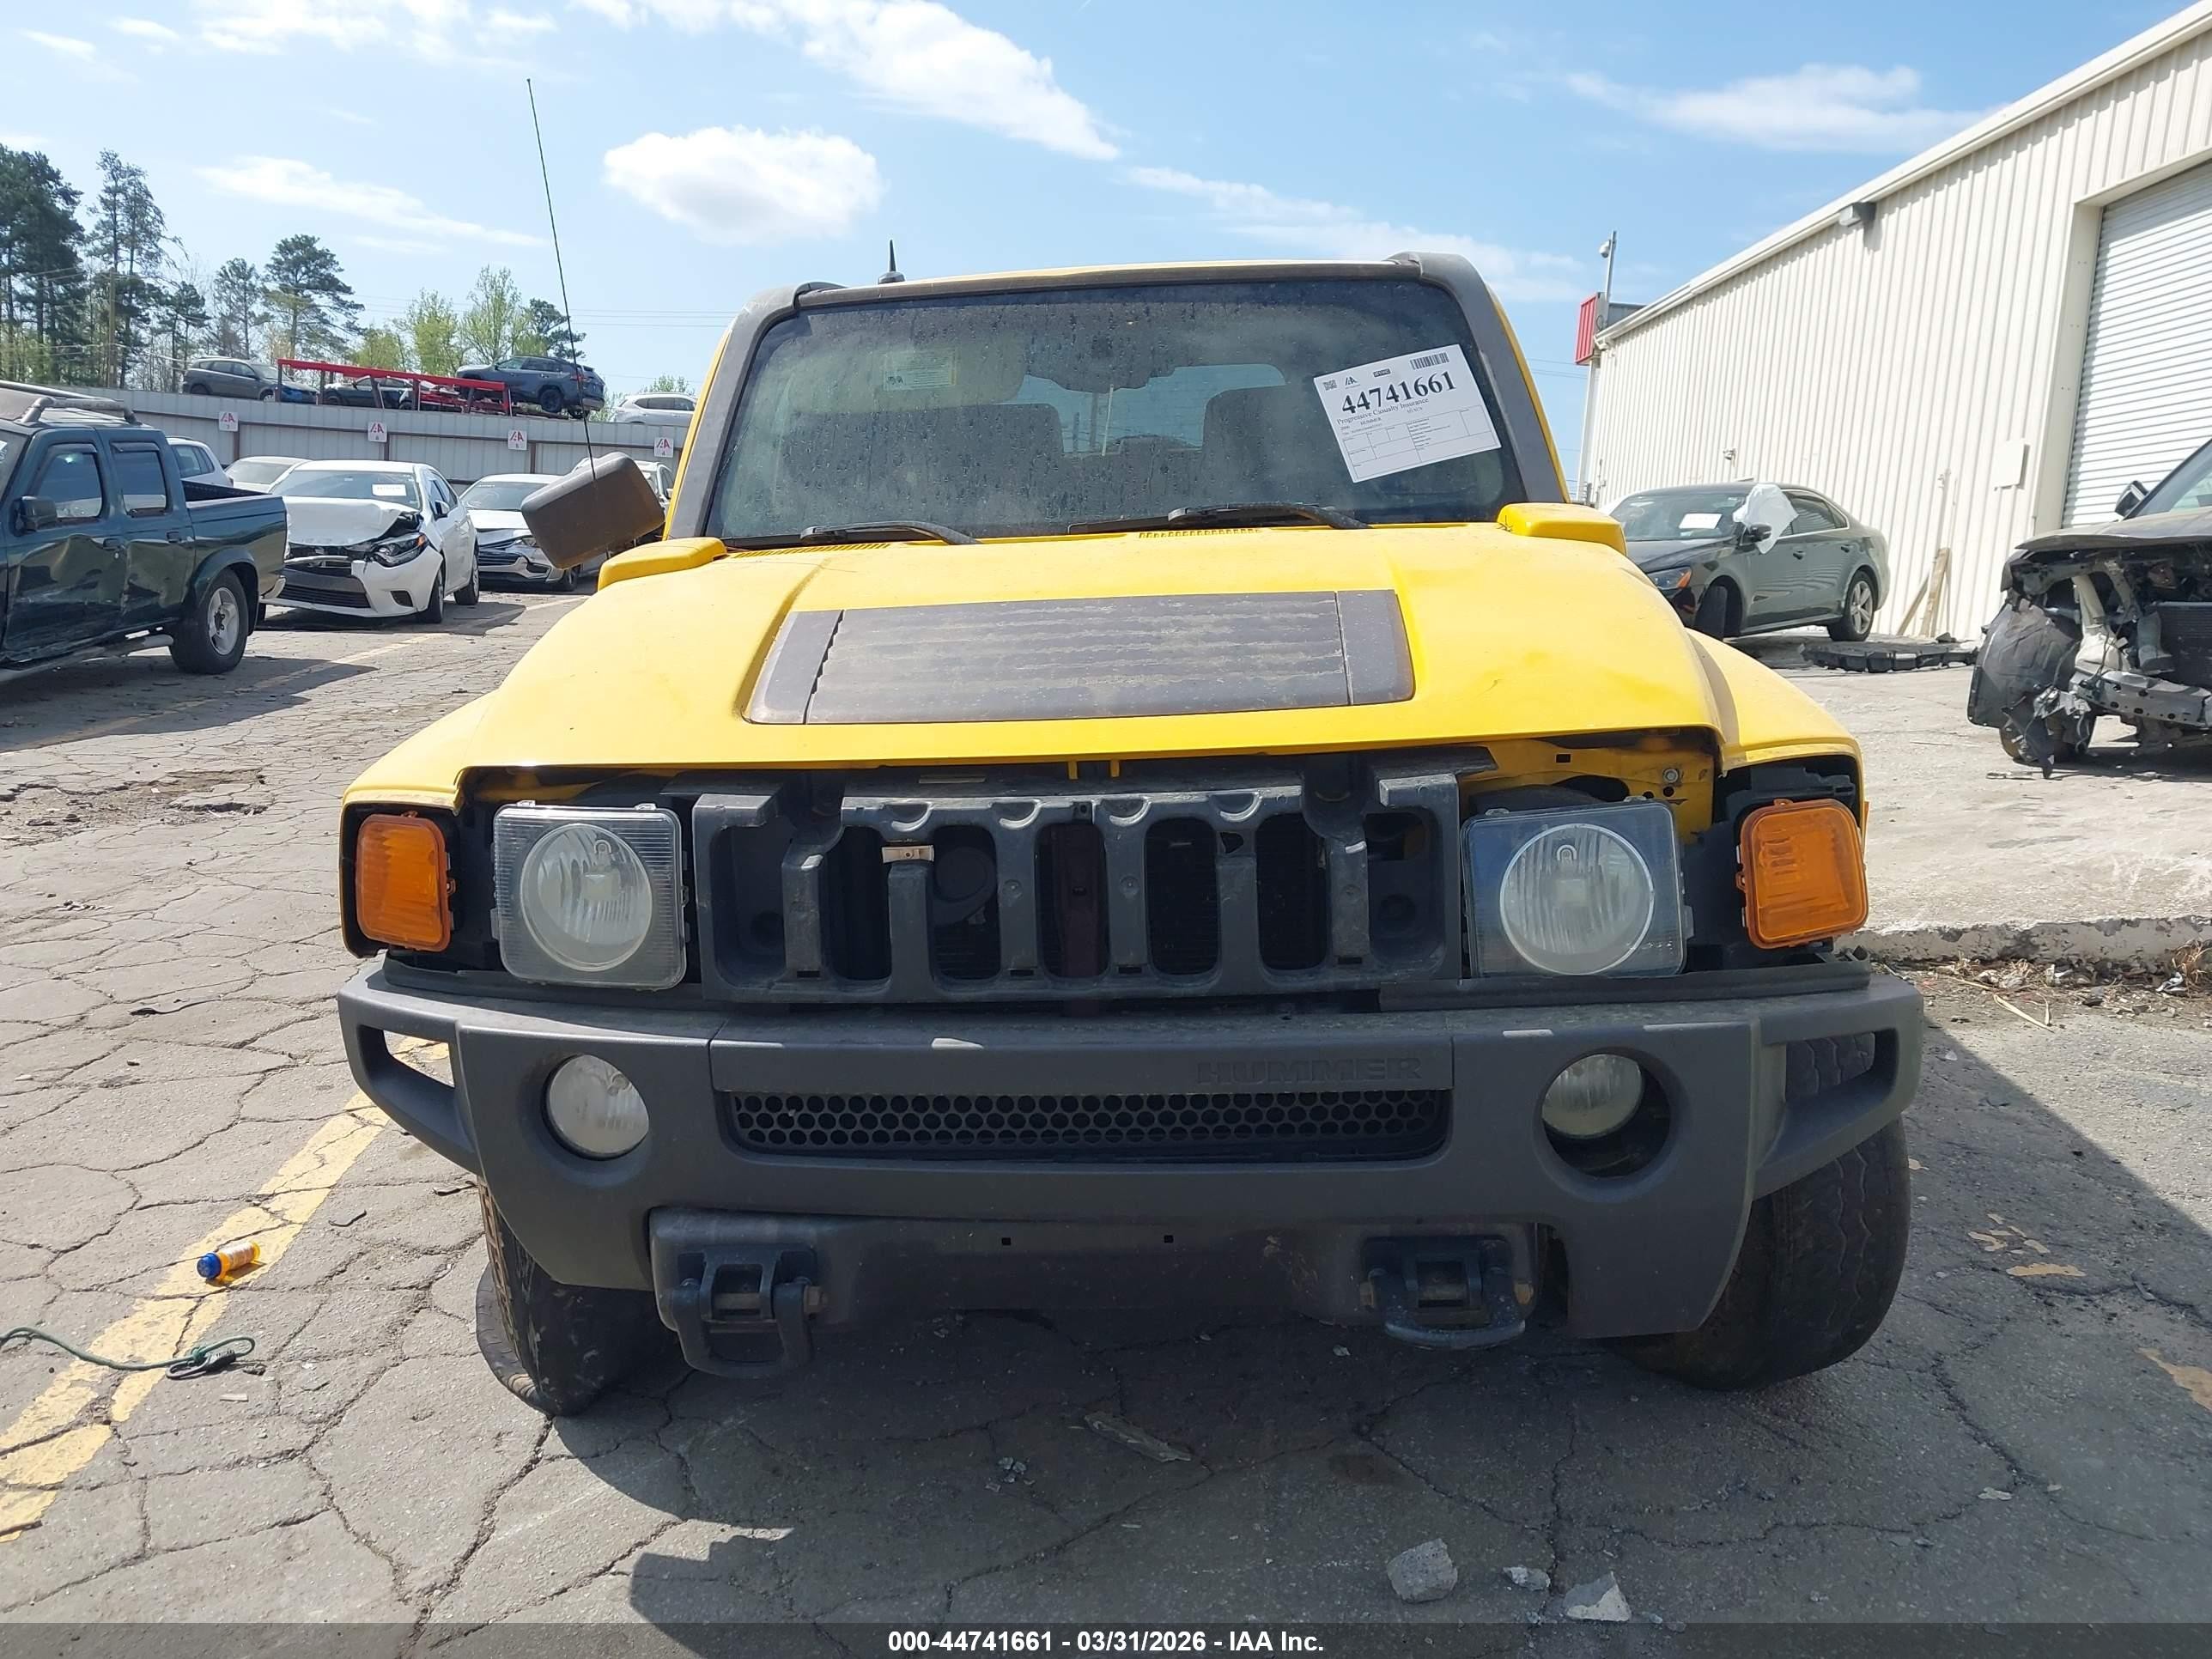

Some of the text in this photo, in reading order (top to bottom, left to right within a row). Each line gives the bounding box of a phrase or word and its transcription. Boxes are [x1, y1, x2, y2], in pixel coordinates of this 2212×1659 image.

[1341, 371, 1456, 414] 44741661
[1337, 411, 1372, 425] Progressive
[1373, 403, 1400, 416] Casualty
[1401, 398, 1429, 409] Insurance
[1197, 1058, 1423, 1085] HUMMER
